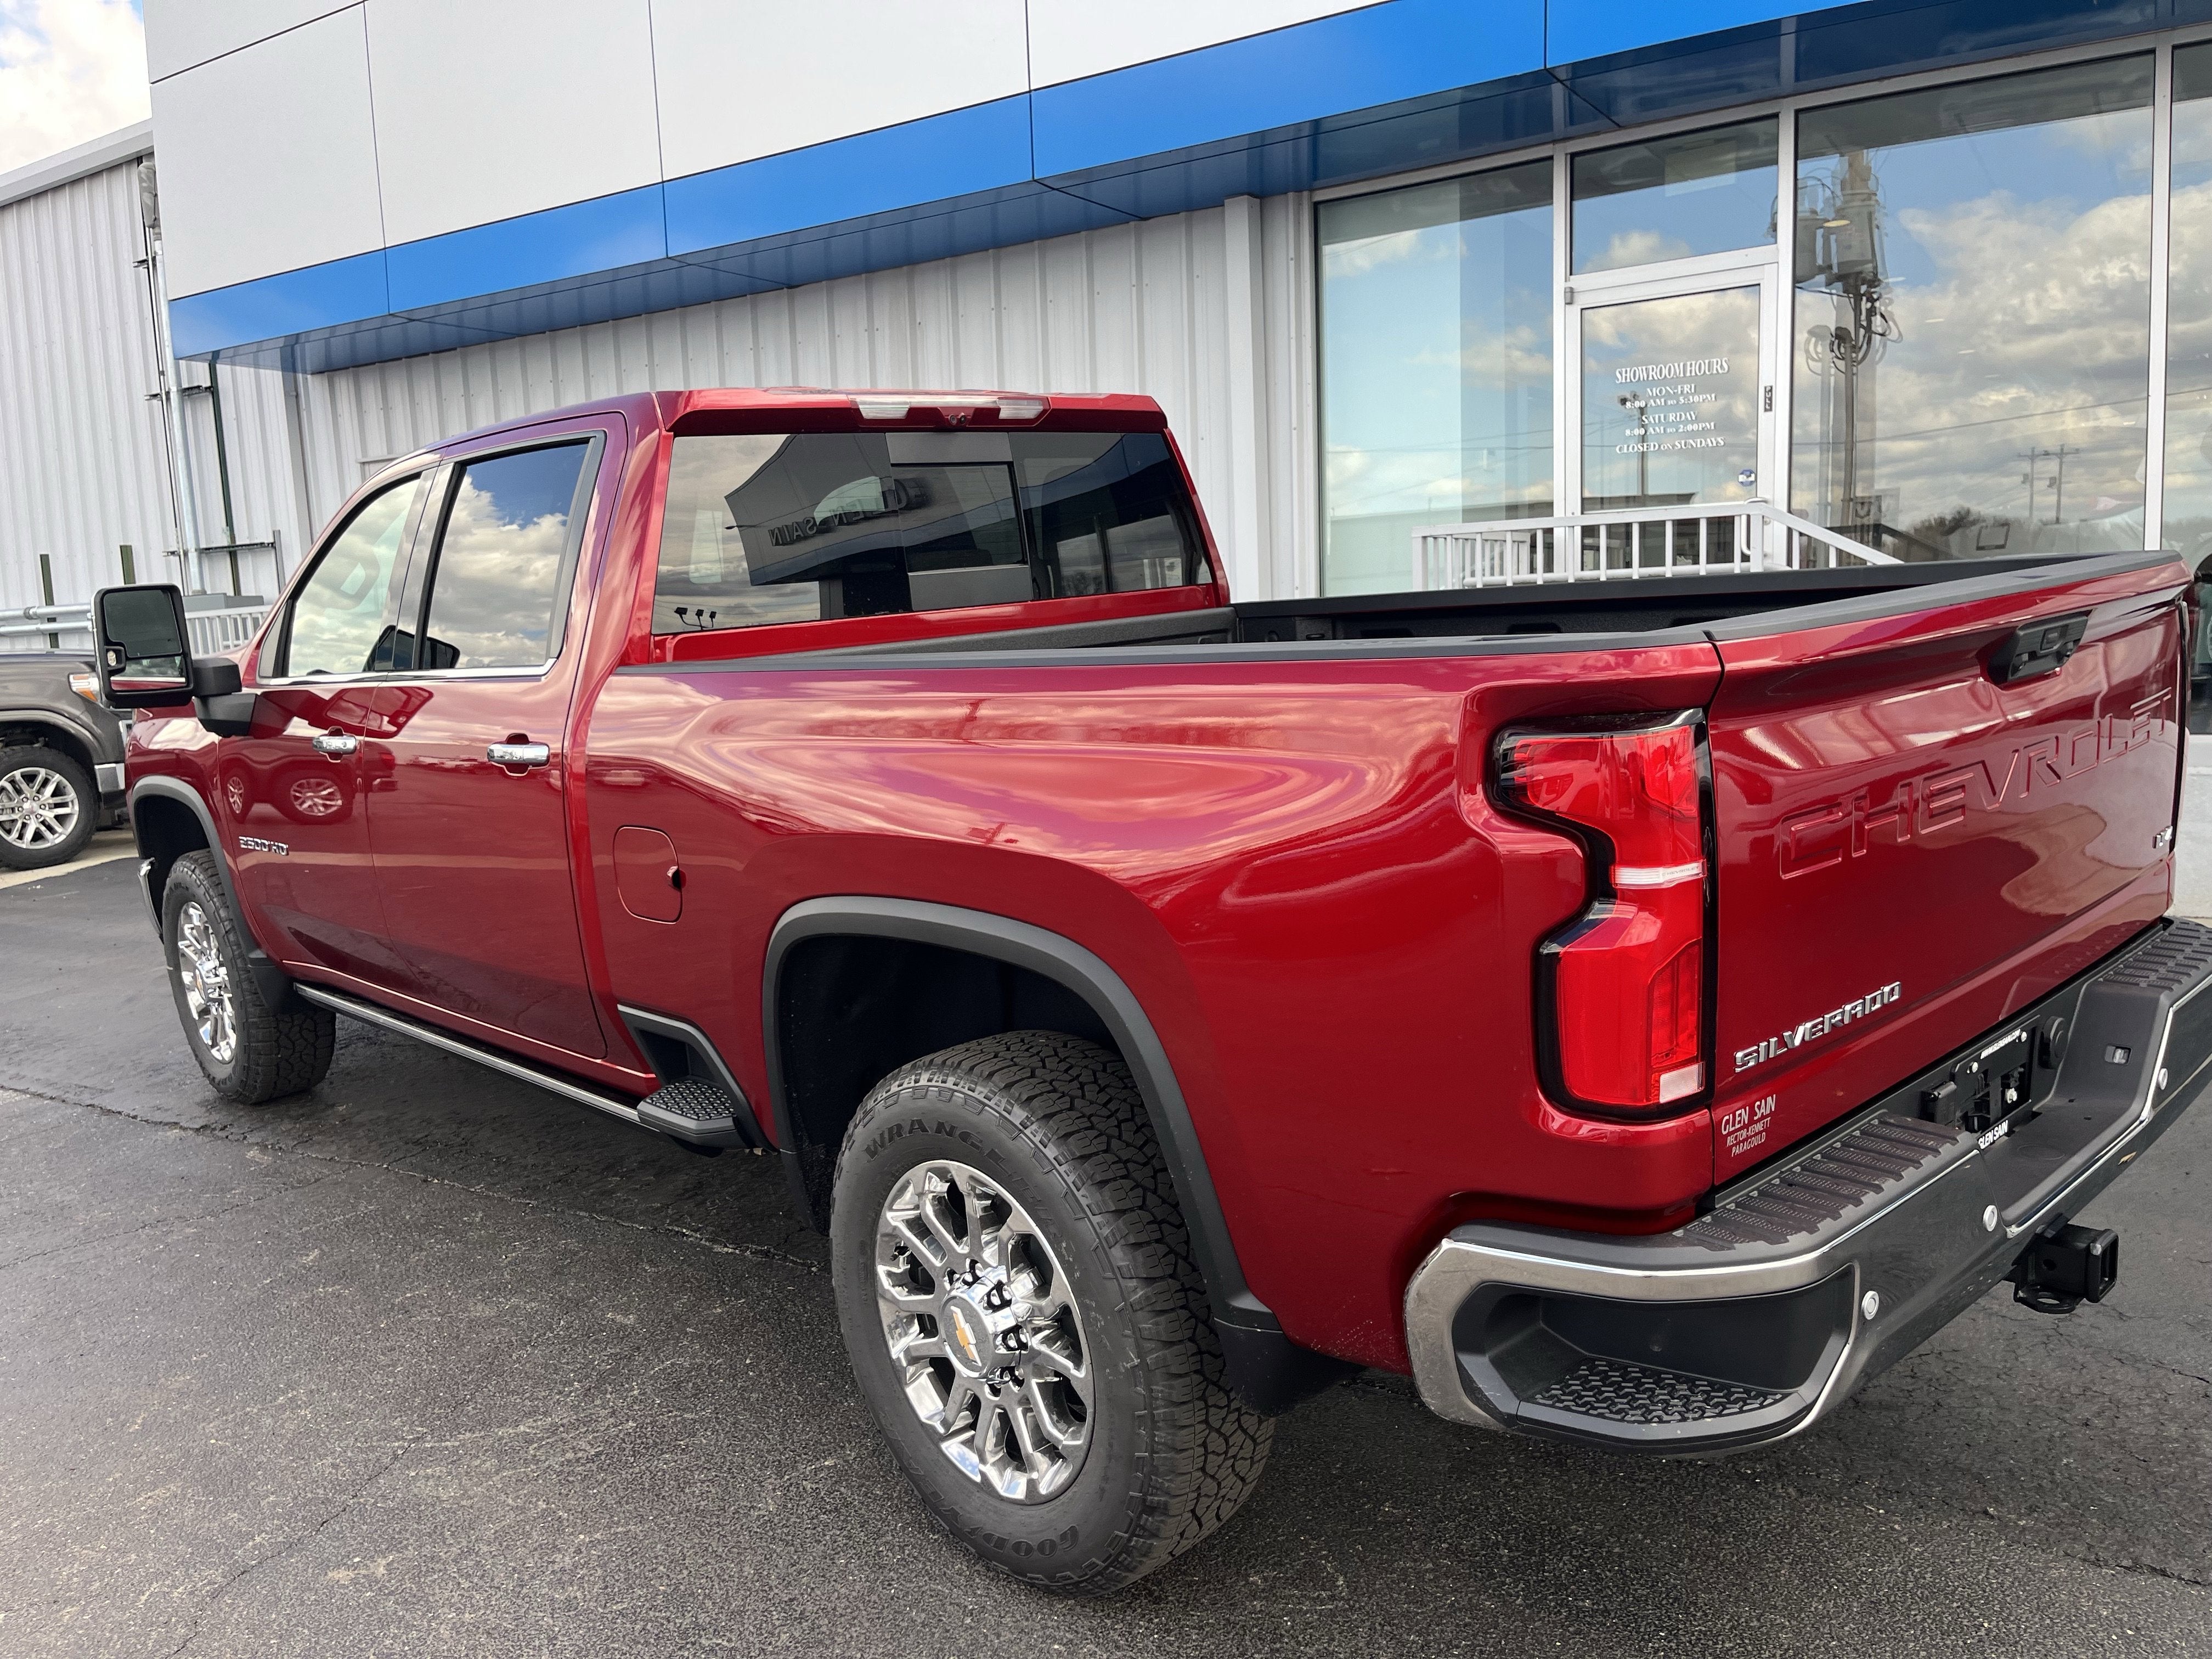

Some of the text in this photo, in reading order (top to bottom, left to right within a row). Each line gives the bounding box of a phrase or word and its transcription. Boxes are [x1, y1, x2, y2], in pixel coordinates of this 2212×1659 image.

[1616, 358, 1729, 383] SHOWROOM HOURS
[1626, 400, 1646, 409] 8:00
[1647, 399, 1665, 407] AM
[1679, 393, 1716, 404] 5:30PM
[1646, 384, 1695, 397] MON-FRI
[1625, 427, 1645, 437] 8:00
[1646, 426, 1664, 435] AM
[1678, 421, 1715, 432] 2:00PM
[1641, 411, 1697, 425] SATURDAY
[1616, 442, 1659, 454] CLOSED
[1674, 437, 1725, 449] SUNDAYS
[1779, 687, 2171, 879] CHEVROLET
[1734, 981, 1901, 1073] SILVERADO
[1722, 1094, 1776, 1135] GLEN SAIN
[1726, 1117, 1771, 1147] RECTOR-KENNETT
[1978, 1120, 2008, 1149] GLEN SAIN
[1731, 1132, 1766, 1158] PARAGOULD
